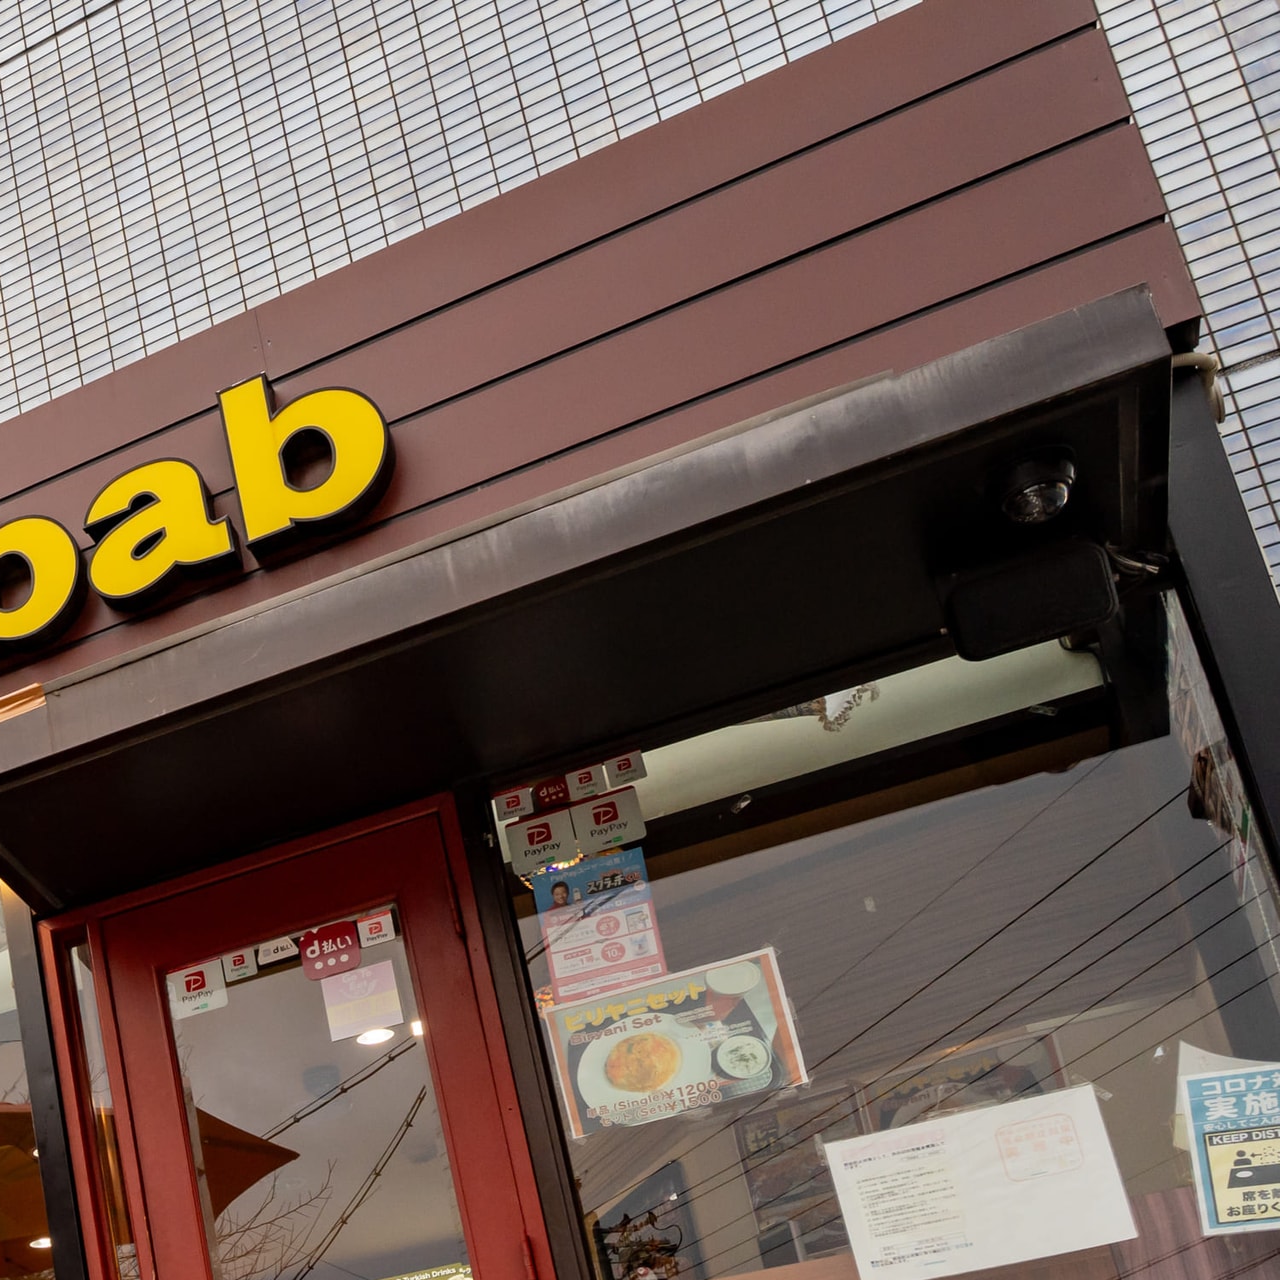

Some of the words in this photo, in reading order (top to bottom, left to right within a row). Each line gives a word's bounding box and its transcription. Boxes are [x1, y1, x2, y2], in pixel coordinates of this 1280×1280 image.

[590, 821, 628, 837] PayPay
[524, 842, 561, 857] PayPay
[366, 933, 388, 942] PayPay
[182, 988, 214, 1003] PayPay
[564, 982, 706, 1031] ビリヤニセット
[632, 1014, 662, 1029] Set
[1212, 1133, 1249, 1145] KEEP
[432, 1267, 456, 1278] Drinks
